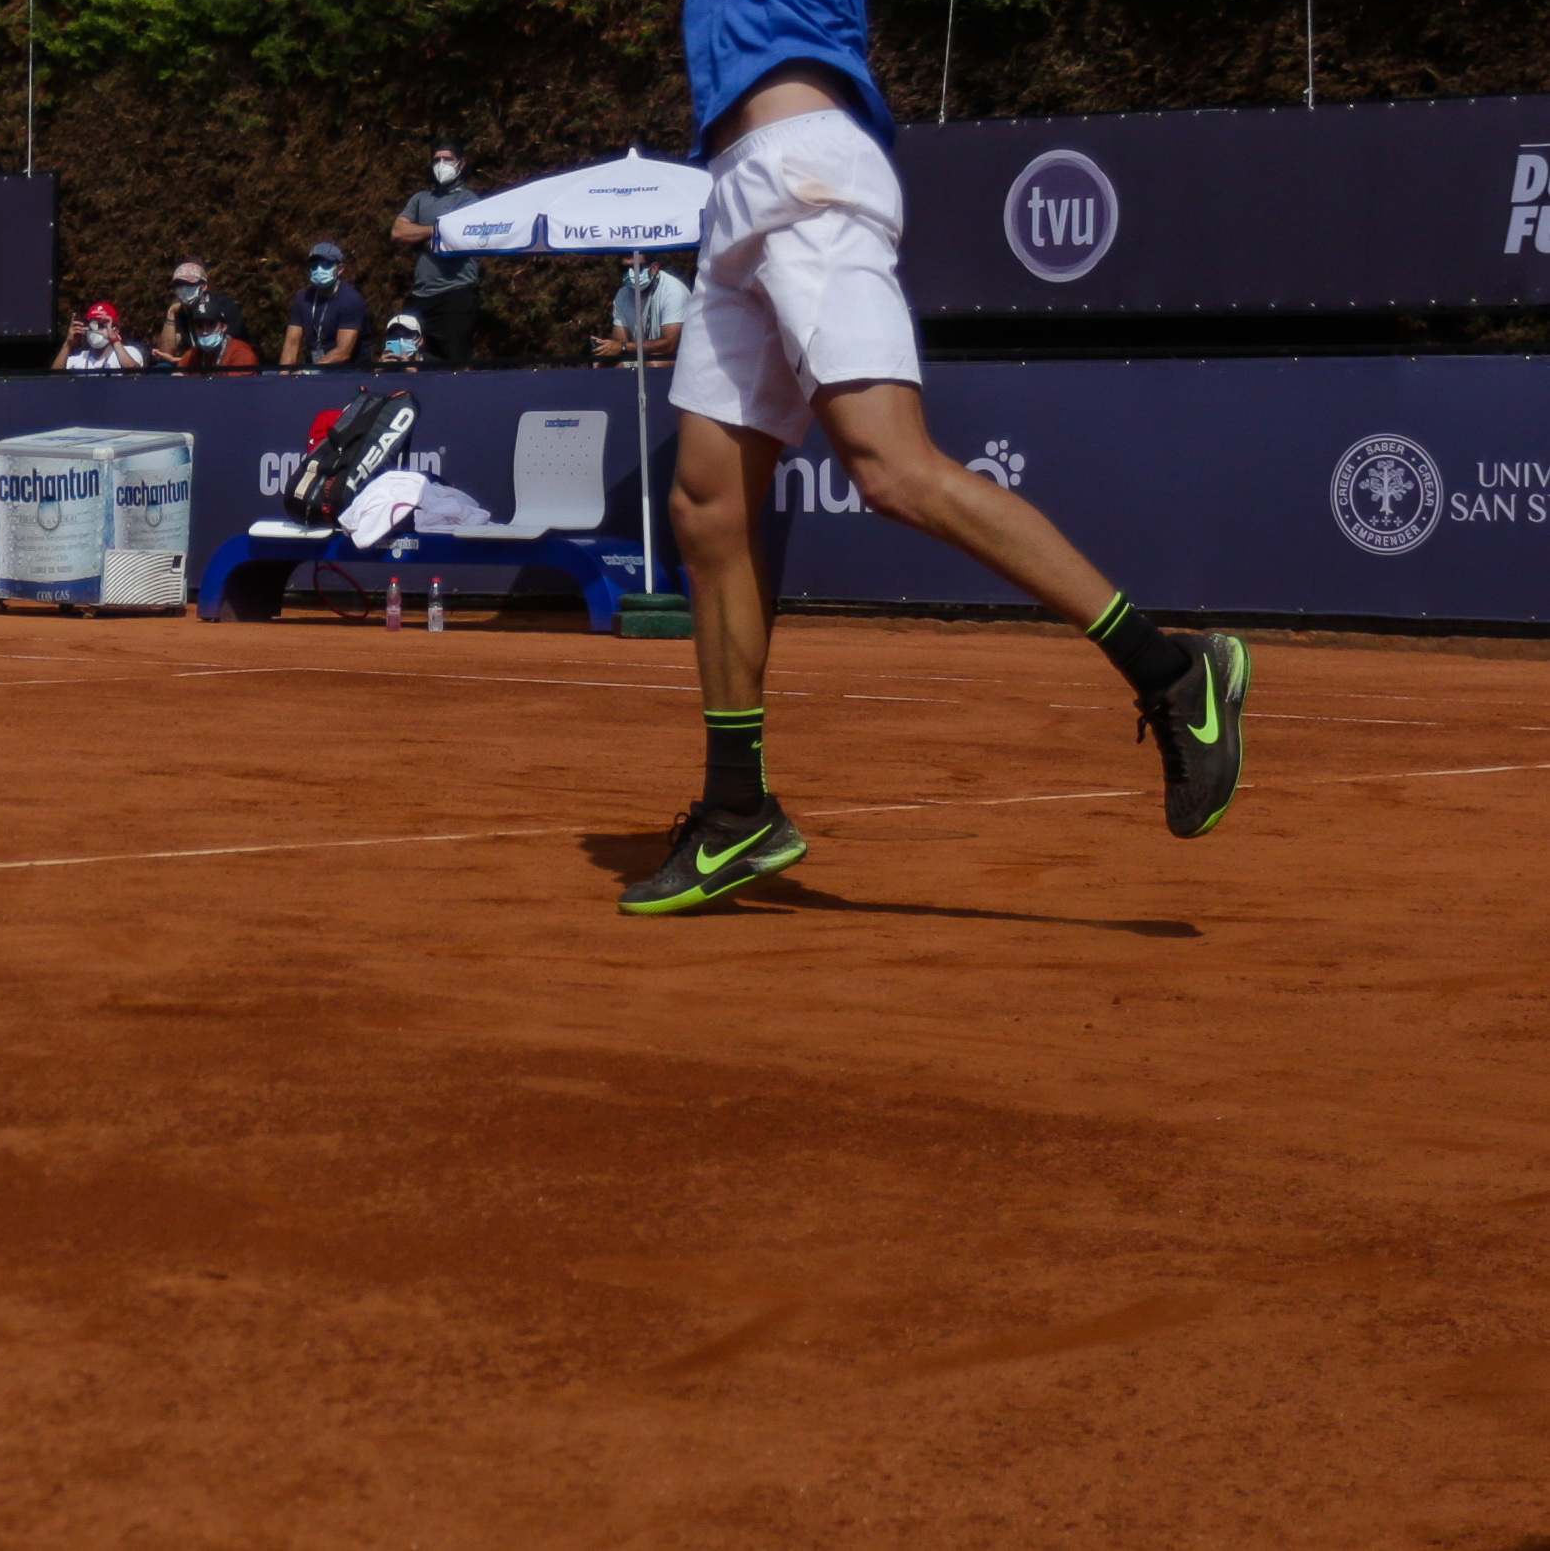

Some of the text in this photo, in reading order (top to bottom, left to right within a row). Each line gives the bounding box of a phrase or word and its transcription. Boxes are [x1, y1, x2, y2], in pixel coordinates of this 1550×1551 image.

[1511, 154, 1550, 202] D
[565, 224, 683, 240] VIVE NATURAL
[1028, 187, 1094, 247] tvu
[346, 407, 415, 491] HEAD
[1365, 442, 1405, 456] SABER
[0, 468, 99, 503] cachantun
[117, 478, 189, 506] cachantun
[1339, 463, 1355, 506] CREER
[1418, 464, 1435, 507] CREAR
[1450, 492, 1550, 523] SAN S
[1351, 522, 1421, 547] EMPRENDER
